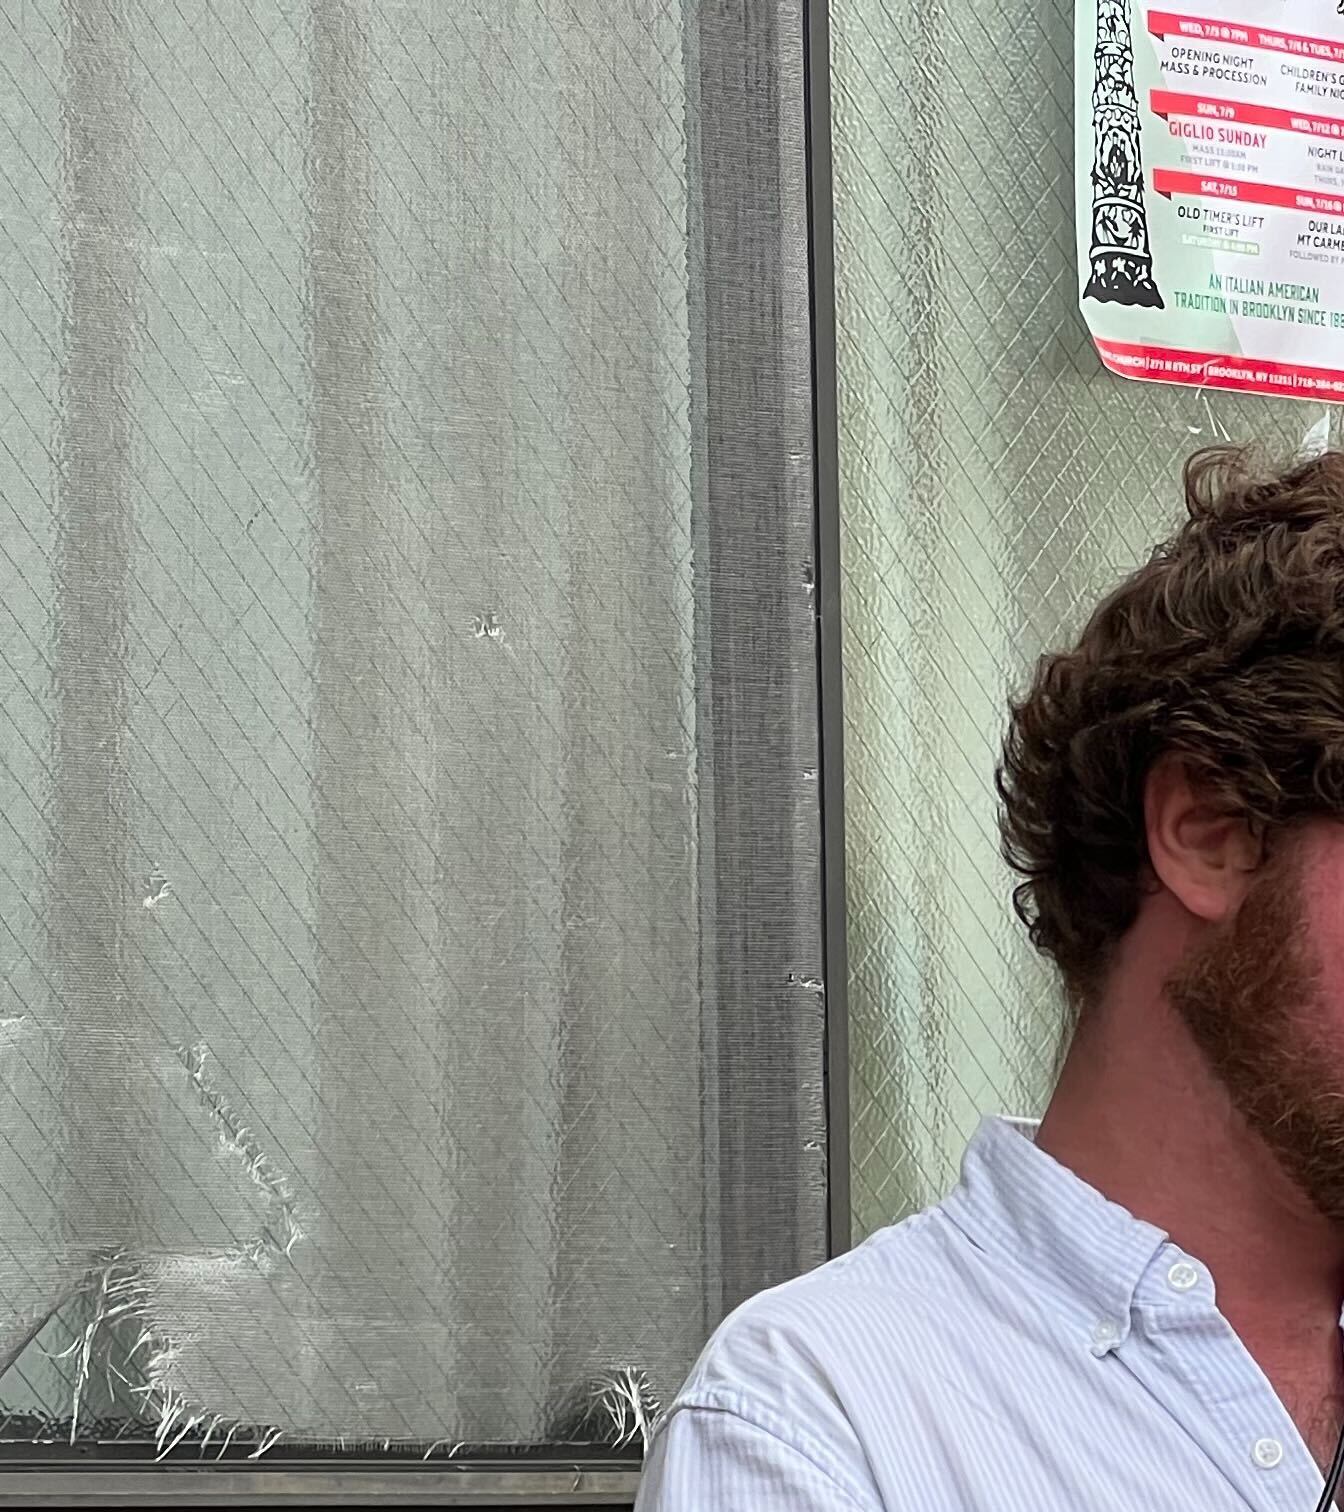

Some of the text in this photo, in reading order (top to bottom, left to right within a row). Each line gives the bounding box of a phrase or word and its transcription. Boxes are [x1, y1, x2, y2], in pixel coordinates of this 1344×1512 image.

[1171, 47, 1254, 70] OPENING NIGHT
[1160, 60, 1268, 87] MASS & PROCESSION
[1280, 64, 1337, 84] CHILDREN'S
[1295, 81, 1328, 98] FAMILY
[1169, 120, 1268, 149] GIGLIO SUNDAY
[1307, 146, 1337, 160] NIGHT
[1177, 205, 1265, 229] OLD TIMER'S LIFT
[1308, 220, 1329, 233] OUR
[1202, 225, 1240, 238] FIRST LIFT
[1297, 234, 1312, 246] MT
[1289, 250, 1329, 263] FOLLOWED
[1208, 273, 1320, 304] AN ITALIAN AMERICAN
[1174, 291, 1227, 315] TRADITION
[1230, 298, 1239, 315] IN
[1242, 299, 1297, 324] BROOKLYN
[1299, 308, 1327, 327] SINCE
